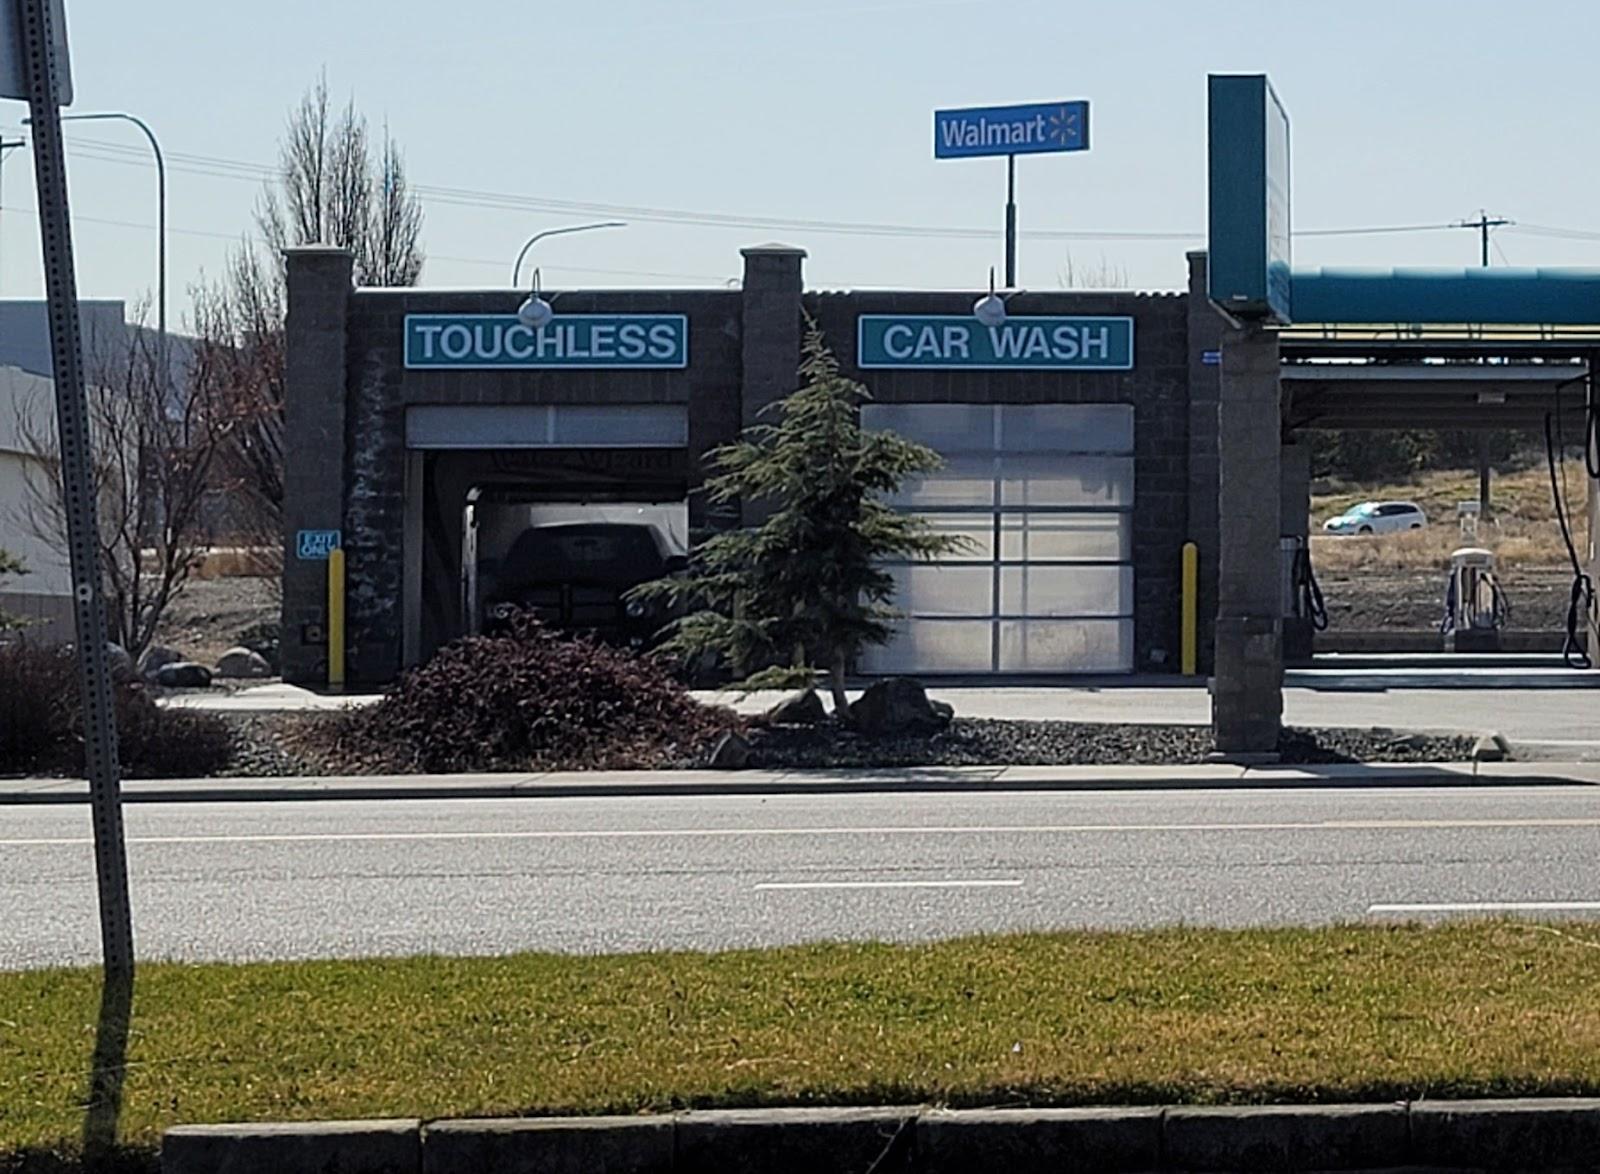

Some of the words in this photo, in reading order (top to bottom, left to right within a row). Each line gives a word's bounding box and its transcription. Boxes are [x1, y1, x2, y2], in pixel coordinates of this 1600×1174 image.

[942, 114, 1045, 147] Walmart
[415, 325, 676, 359] TOUCHLESS
[883, 324, 970, 360] CAR
[988, 326, 1109, 360] WASH
[301, 544, 335, 556] ONLY
[304, 533, 332, 545] EXIT
